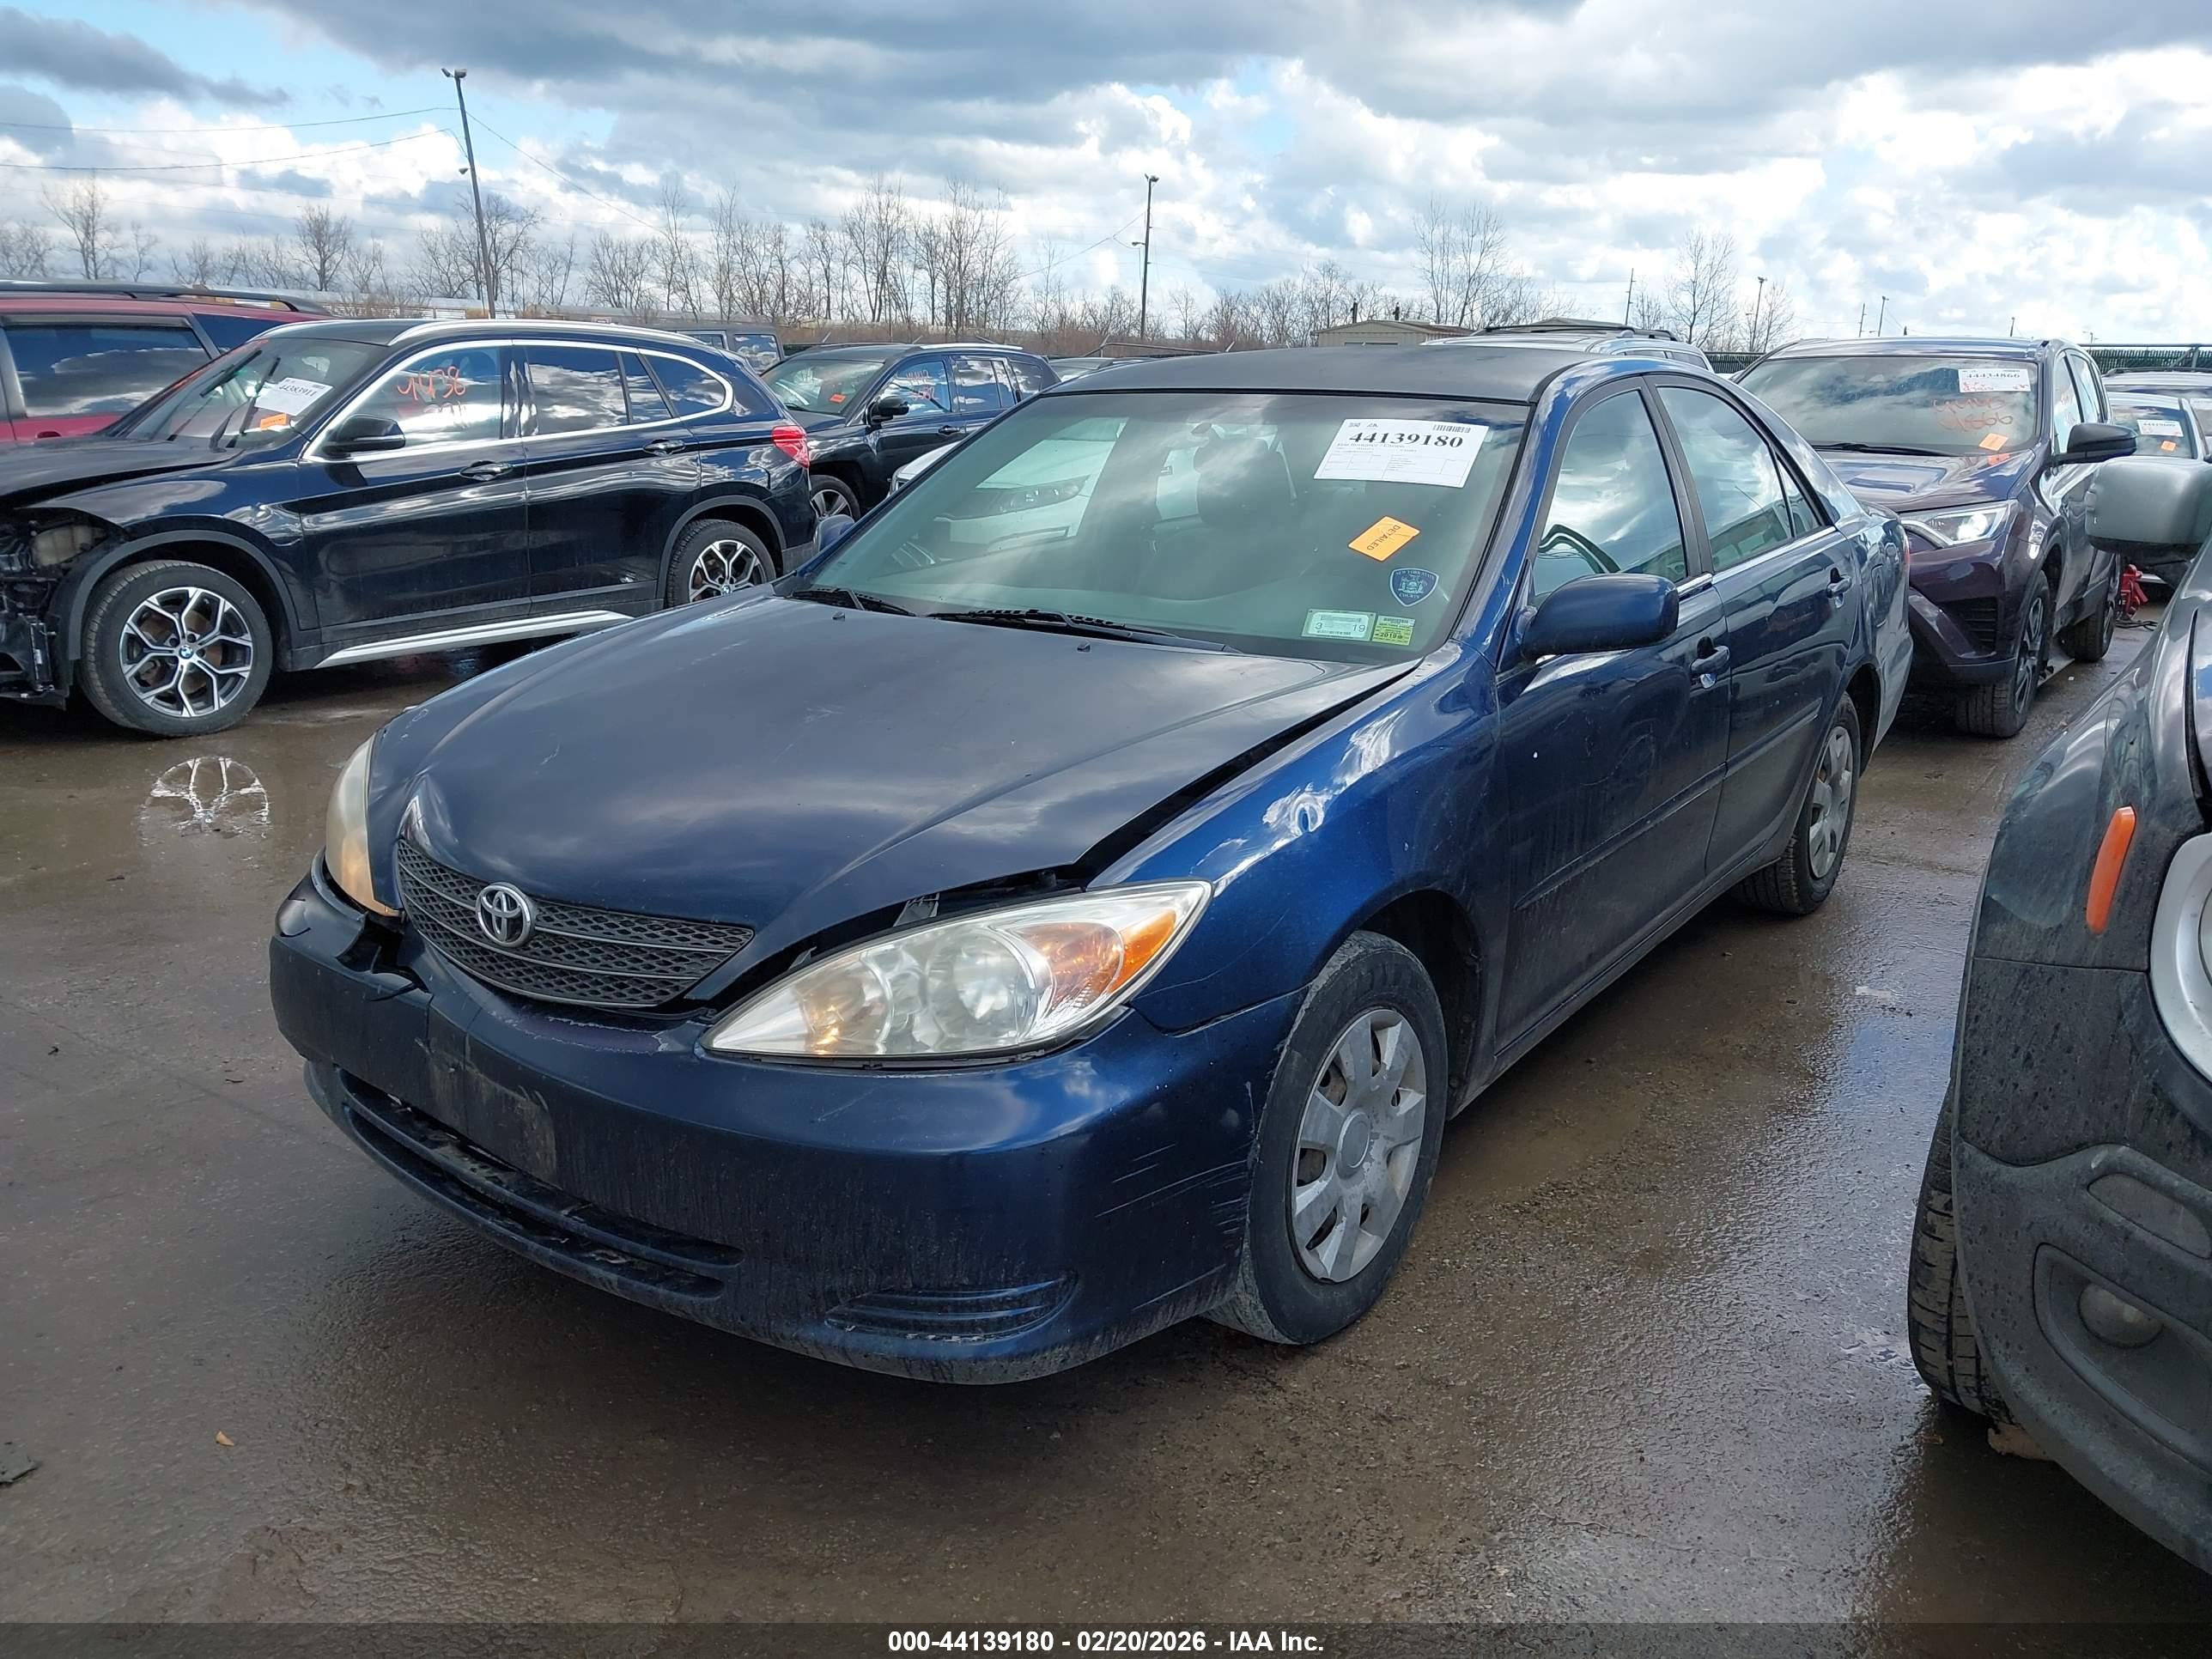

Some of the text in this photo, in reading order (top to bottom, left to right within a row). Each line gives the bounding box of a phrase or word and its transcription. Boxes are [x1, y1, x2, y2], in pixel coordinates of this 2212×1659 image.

[1349, 432, 1463, 447] 44139180
[1366, 524, 1401, 550] DETAILED
[1352, 624, 1366, 633] 19
